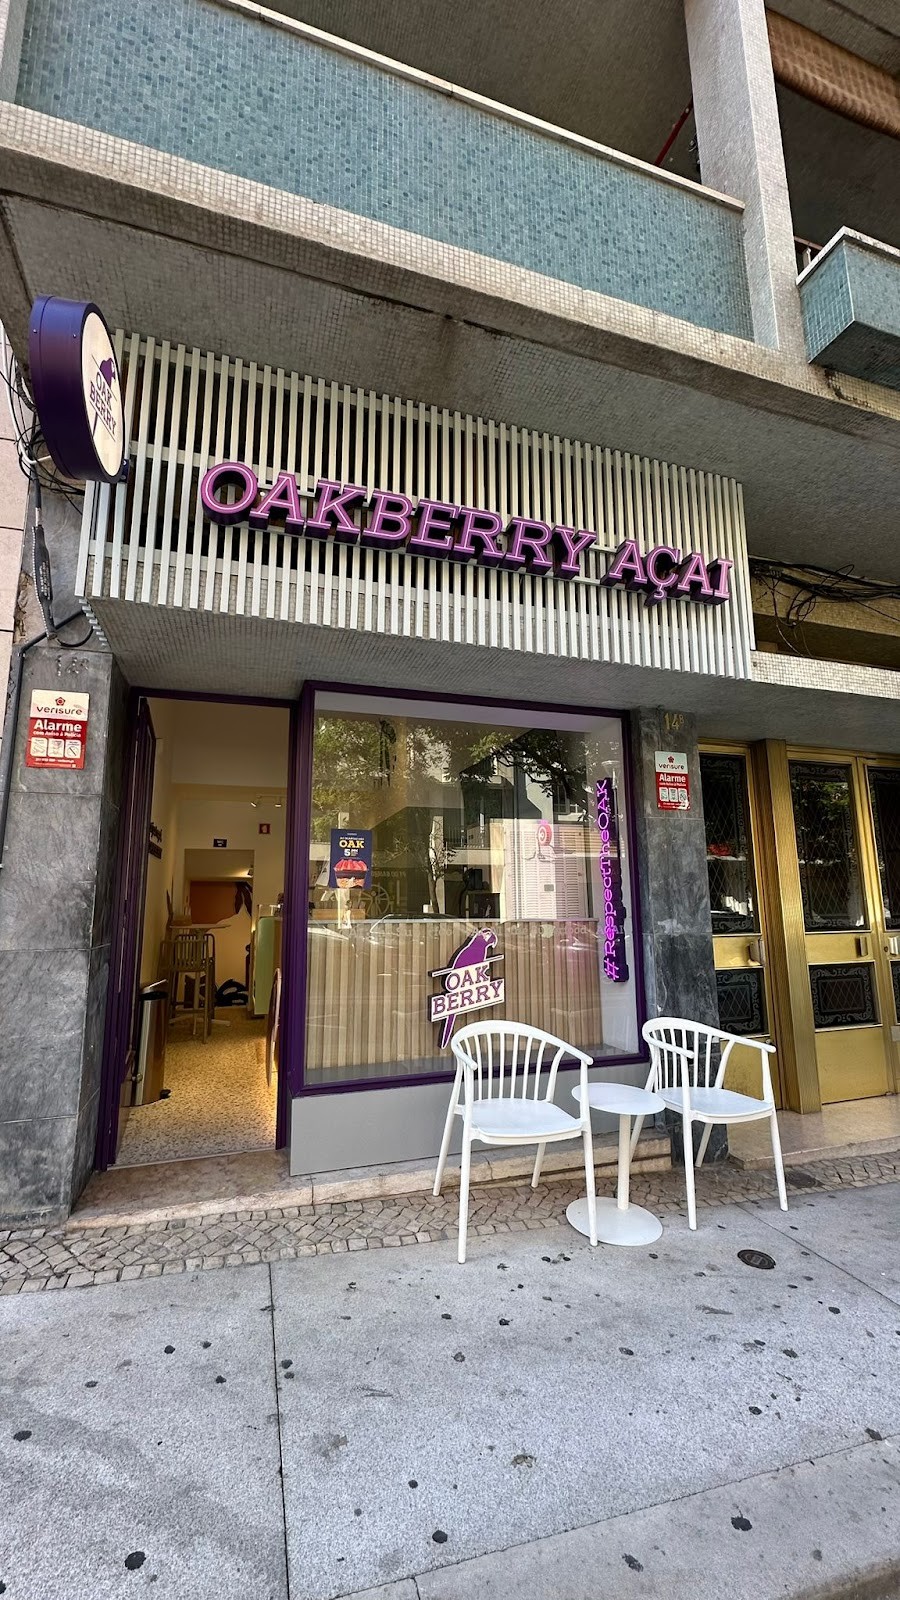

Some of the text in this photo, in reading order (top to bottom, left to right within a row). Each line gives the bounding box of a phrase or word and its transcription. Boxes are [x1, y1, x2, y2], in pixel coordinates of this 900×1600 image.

[96, 371, 113, 411] OAK
[90, 382, 116, 436] BERRY
[201, 462, 597, 577] OAKBERRY
[34, 719, 82, 732] Alarme
[36, 706, 82, 715] verisure
[659, 773, 685, 782] Alarme
[339, 840, 364, 848] OAK
[596, 779, 620, 981] #RespectTheOAK
[446, 964, 490, 991] OAK
[433, 980, 503, 1016] BERRY
